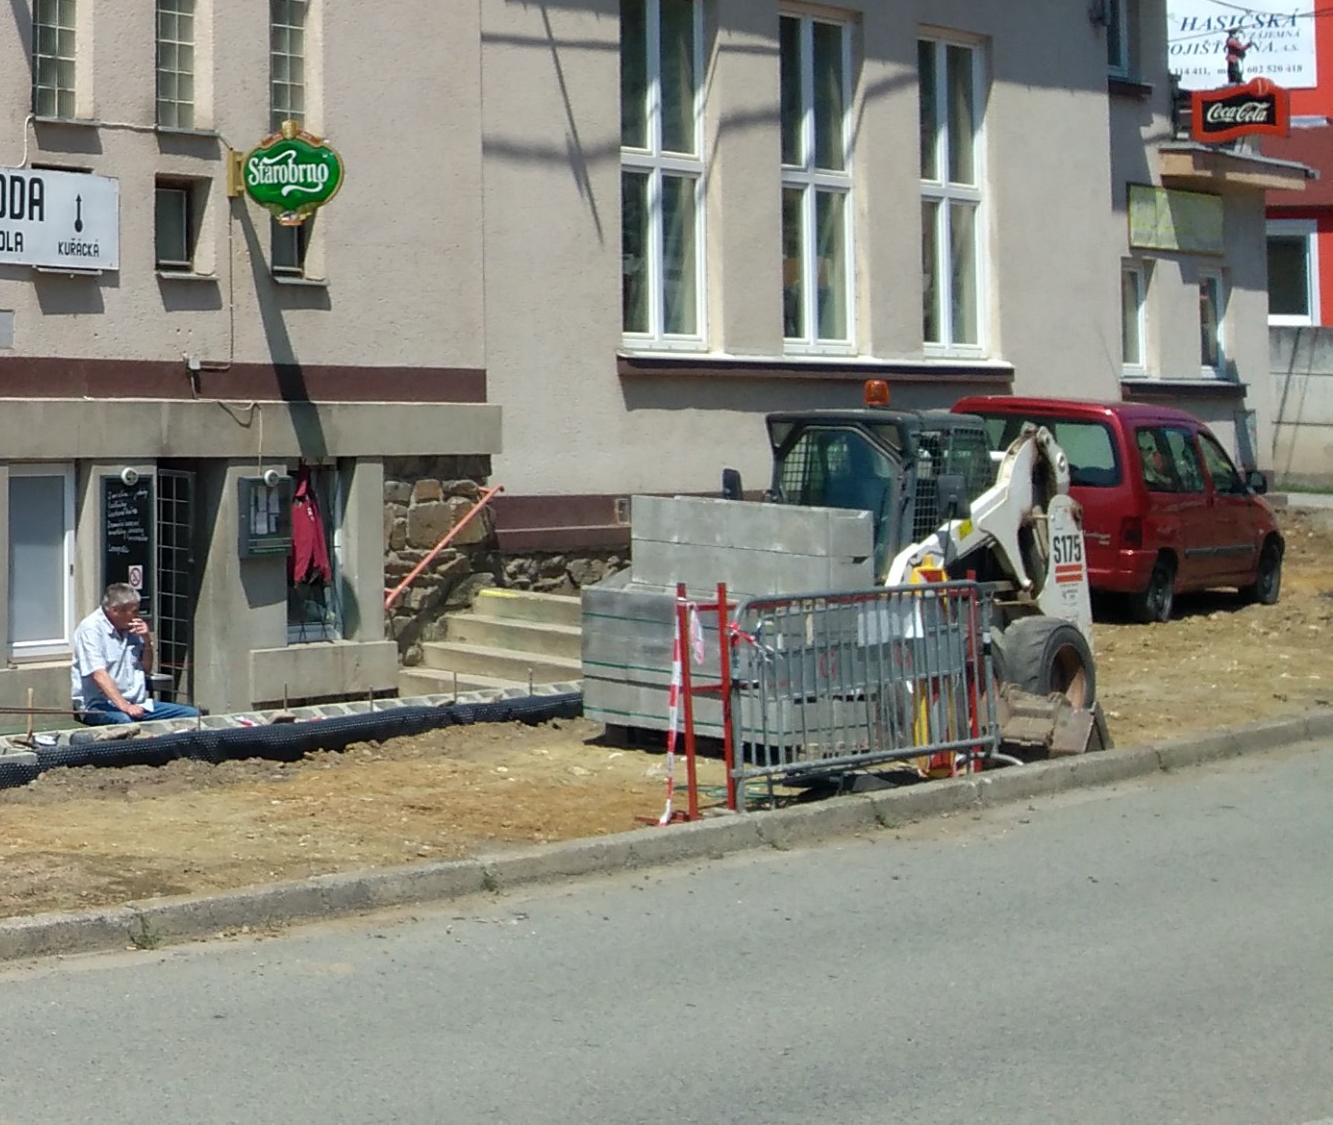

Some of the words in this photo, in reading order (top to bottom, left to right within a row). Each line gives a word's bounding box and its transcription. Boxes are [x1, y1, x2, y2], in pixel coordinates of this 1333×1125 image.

[1180, 8, 1300, 31] HASIČSKÁ
[248, 150, 329, 196] Starobrno
[58, 238, 100, 258] KUŘÁCKÁ
[1053, 535, 1082, 564] S175
